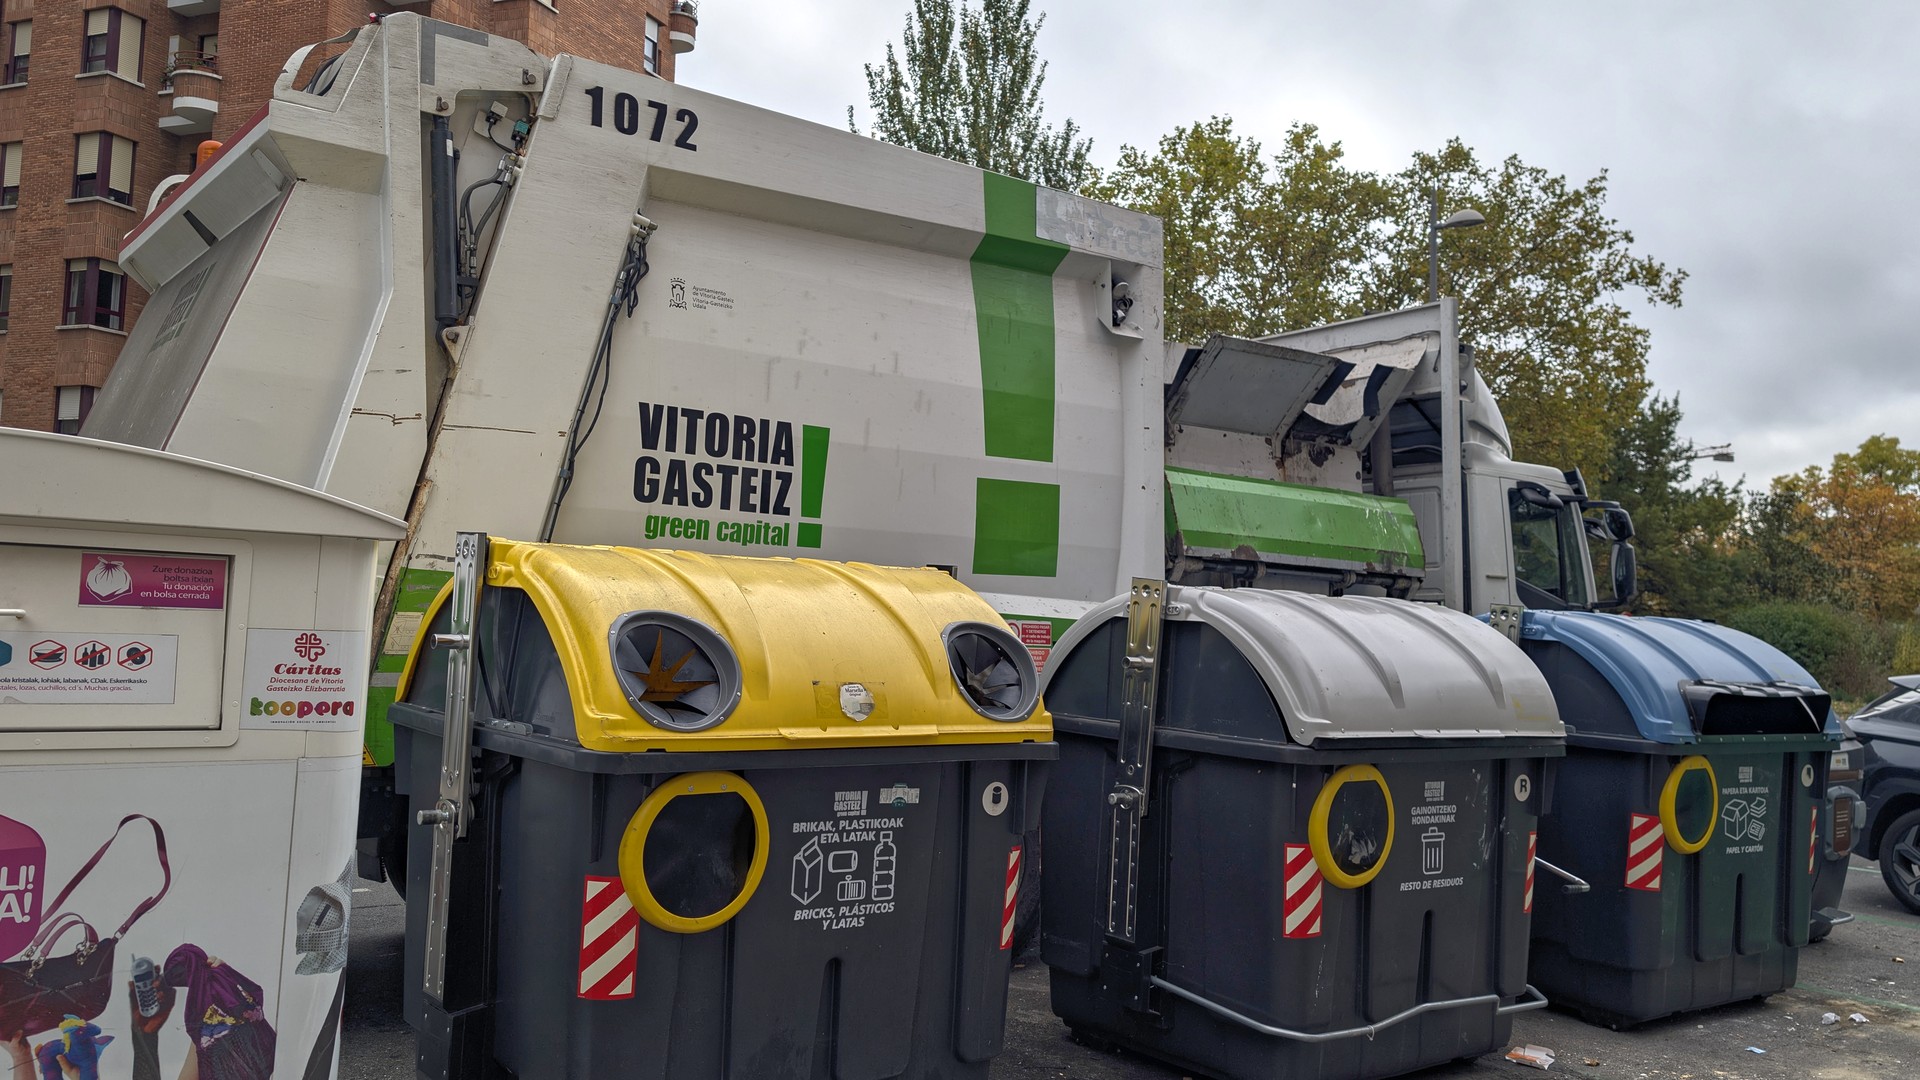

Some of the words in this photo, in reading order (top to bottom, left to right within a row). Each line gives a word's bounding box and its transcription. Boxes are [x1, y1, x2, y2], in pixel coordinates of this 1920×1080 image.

[585, 86, 698, 151] 1072
[692, 286, 726, 296] Ayuntamiento
[700, 292, 734, 303] Vitoria-Gasteiz
[692, 298, 733, 309] Vitoria-Gasteizko
[638, 402, 794, 466] VITORIA
[633, 456, 792, 516] GASTEIZ
[644, 514, 710, 540] green
[716, 520, 790, 546] capital
[152, 566, 172, 574] Zure
[174, 566, 212, 575] donazioa
[164, 574, 189, 582] boltsa
[174, 583, 214, 591] donación
[154, 590, 176, 598] bolsa
[178, 591, 210, 600] cerrada
[274, 663, 342, 675] Cáritas
[250, 697, 354, 718] koopera
[1520, 779, 1528, 793] R
[835, 791, 861, 801] VITORIA
[834, 801, 861, 811] GASTEIZ
[1411, 805, 1457, 815] GAINONTZEKO
[1412, 814, 1456, 825] HONDAKINAK
[793, 821, 836, 833] BRIKAK,
[839, 818, 904, 830] PLASTIKOAK
[820, 833, 840, 844] ETA
[843, 831, 876, 842] LATAK
[1726, 846, 1740, 854] PAPEL
[1745, 843, 1763, 853] CARTÓN
[1400, 880, 1421, 891] RESTO
[1422, 880, 1432, 890] DE
[1433, 877, 1464, 889] RESIDUOS
[794, 907, 835, 920] BRICKS,
[839, 902, 895, 917] PLÁSTICOS
[822, 920, 830, 930] Y
[832, 917, 865, 929] LATAS
